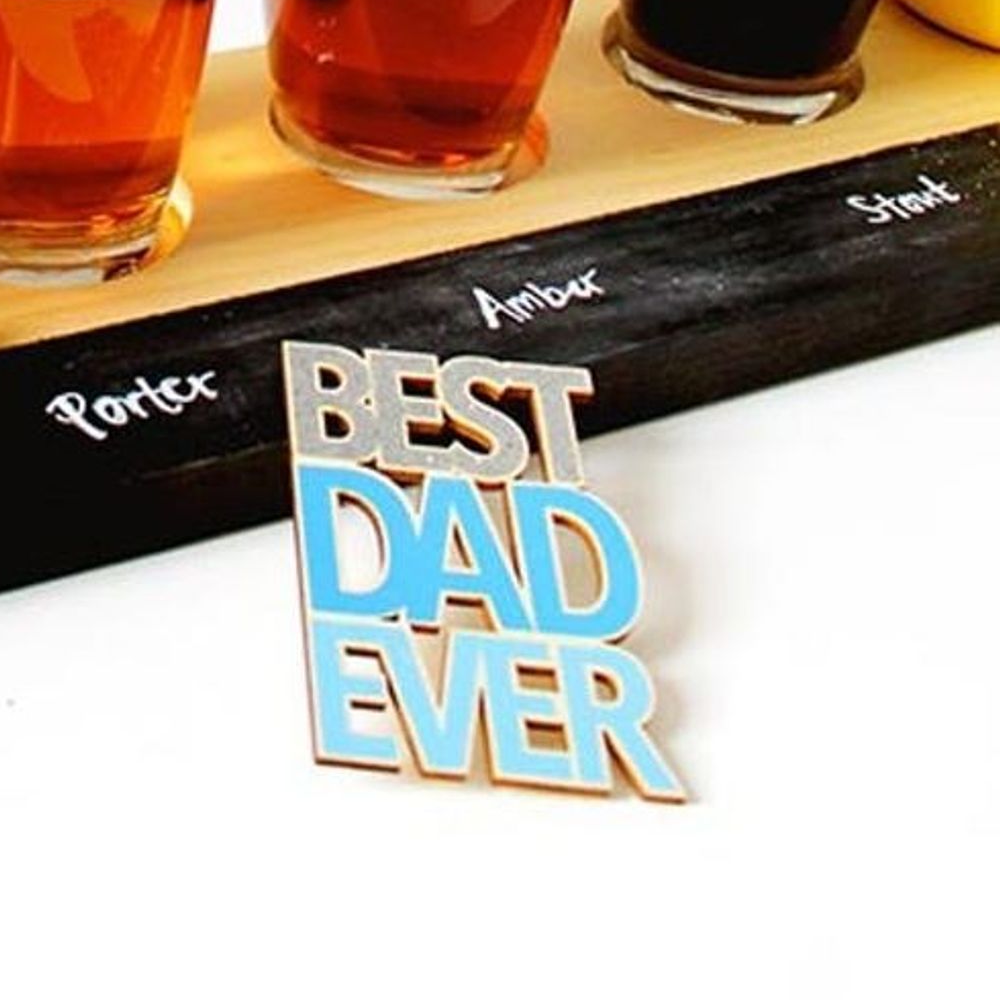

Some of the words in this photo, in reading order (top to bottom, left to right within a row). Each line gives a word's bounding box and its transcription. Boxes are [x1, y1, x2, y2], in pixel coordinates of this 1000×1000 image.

[847, 176, 961, 224] Stout
[472, 267, 604, 329] Amber
[45, 369, 218, 439] Porter
[283, 341, 594, 485] BEST
[295, 460, 643, 642] DAD
[307, 613, 687, 803] EVER
